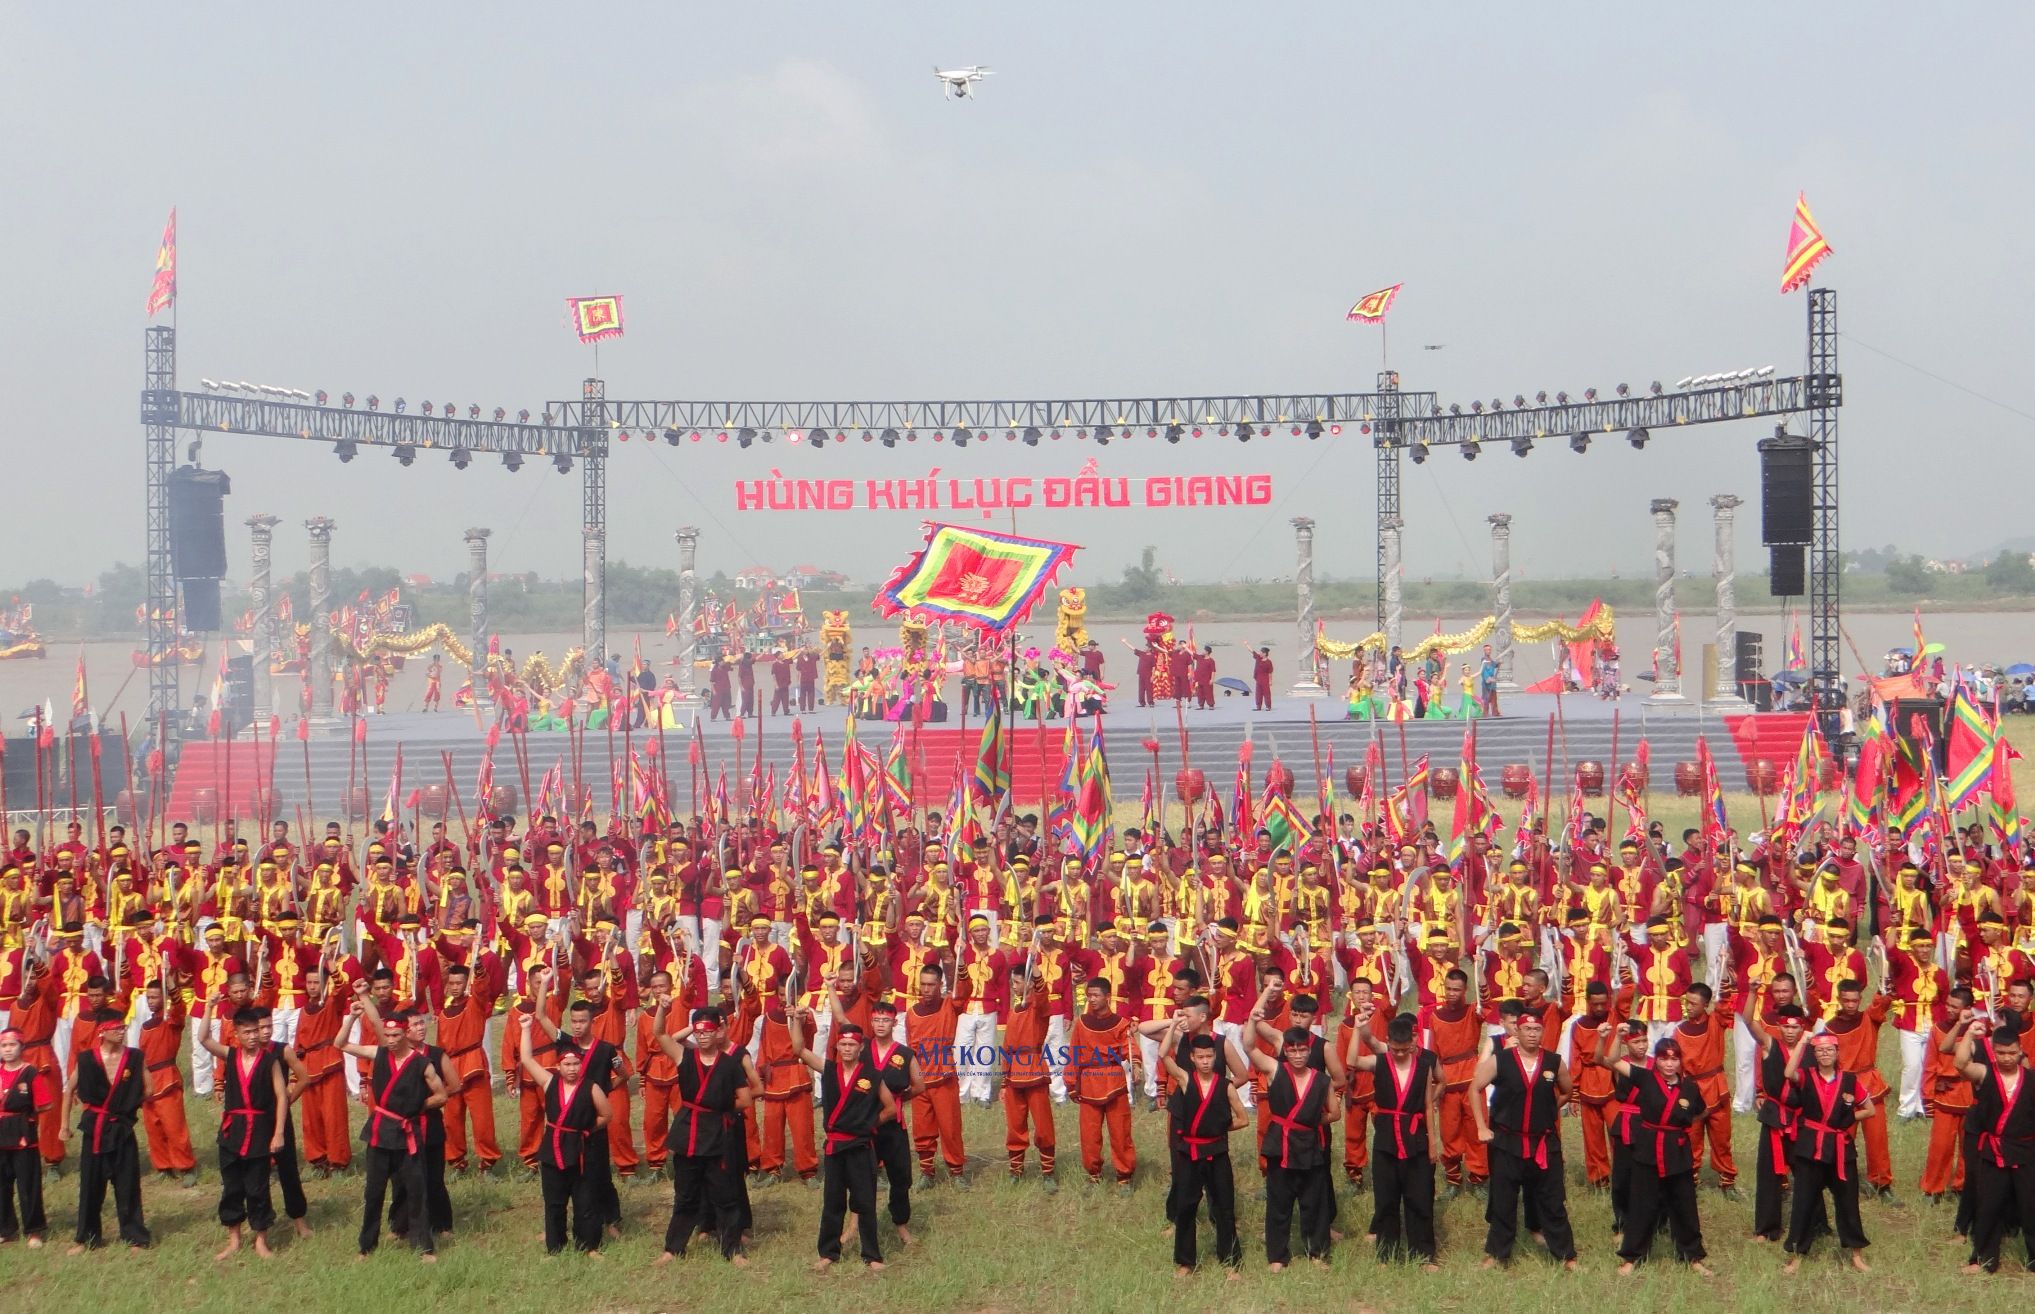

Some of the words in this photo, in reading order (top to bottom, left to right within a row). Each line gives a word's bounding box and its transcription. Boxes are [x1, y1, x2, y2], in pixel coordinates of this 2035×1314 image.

[735, 467, 855, 511] HÙNG
[866, 466, 942, 510] KHÍ
[949, 477, 1033, 519] LỤC
[1043, 457, 1132, 508] ĐẦU
[1145, 474, 1273, 508] GIANG
